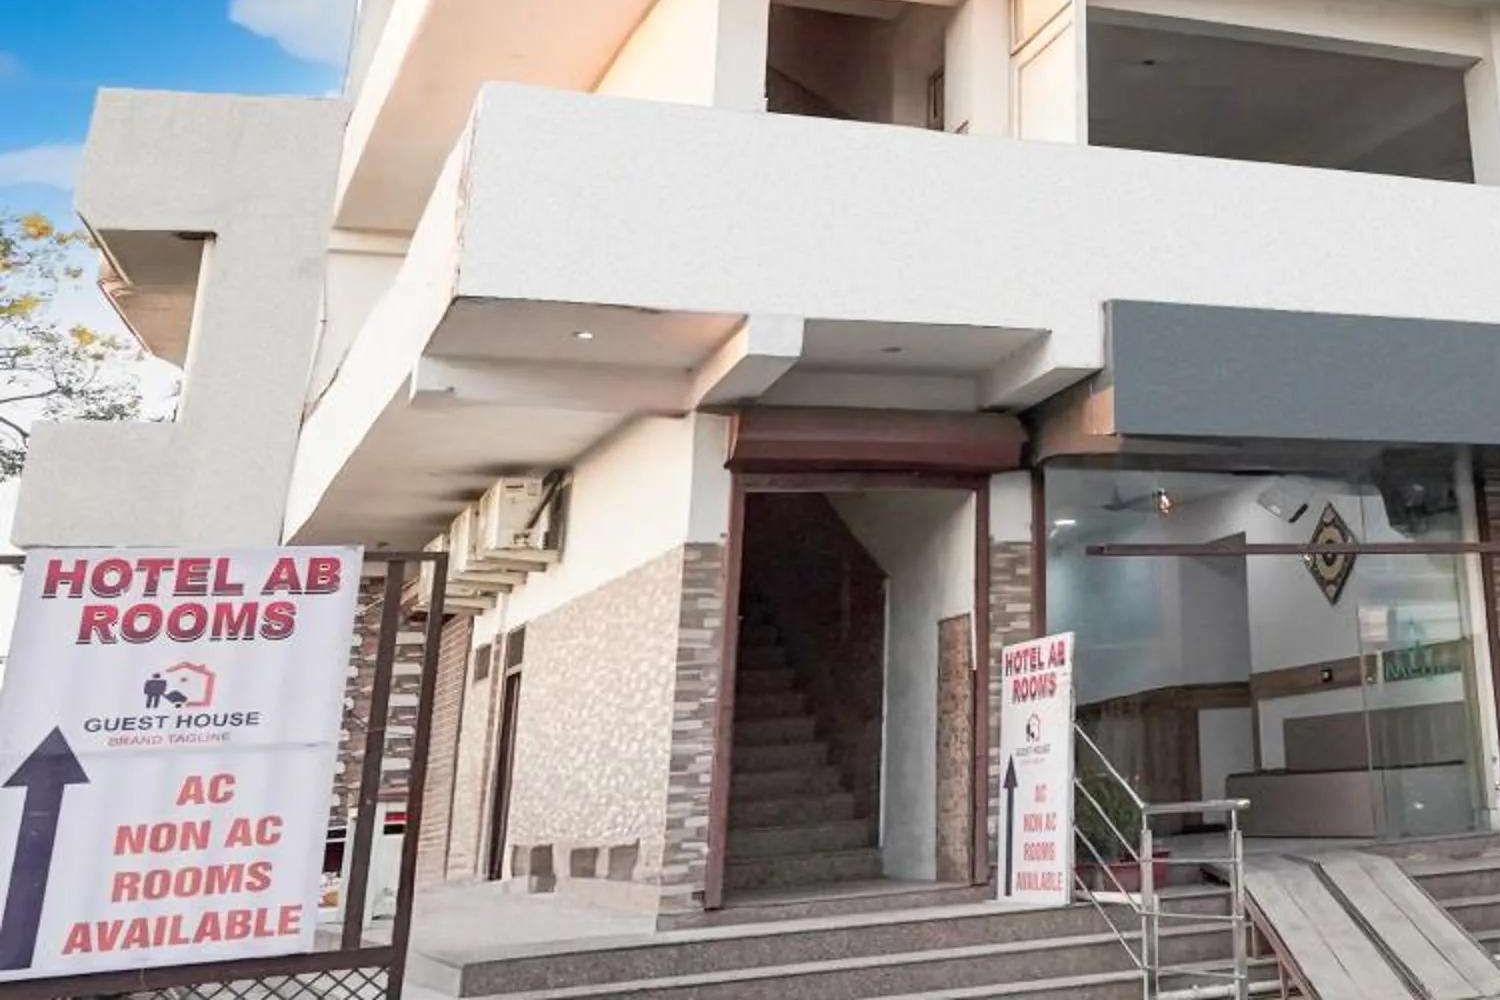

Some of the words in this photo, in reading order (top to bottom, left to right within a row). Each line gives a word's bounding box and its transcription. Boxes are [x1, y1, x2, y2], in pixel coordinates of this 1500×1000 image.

[41, 557, 244, 599] HOTEL
[260, 556, 342, 595] AB
[75, 600, 297, 645] ROOMS
[1005, 645, 1044, 677] HOTEL
[1048, 640, 1065, 669] AB
[1012, 672, 1057, 704] ROOMS
[83, 714, 170, 734] GUEST
[175, 711, 261, 729] HOUSE
[167, 731, 233, 744] TAGLINE
[176, 773, 237, 806] AC
[113, 822, 212, 856] NON
[224, 815, 284, 848] AC
[110, 860, 274, 903] ROOMS
[61, 904, 305, 956] AVAILABLE
